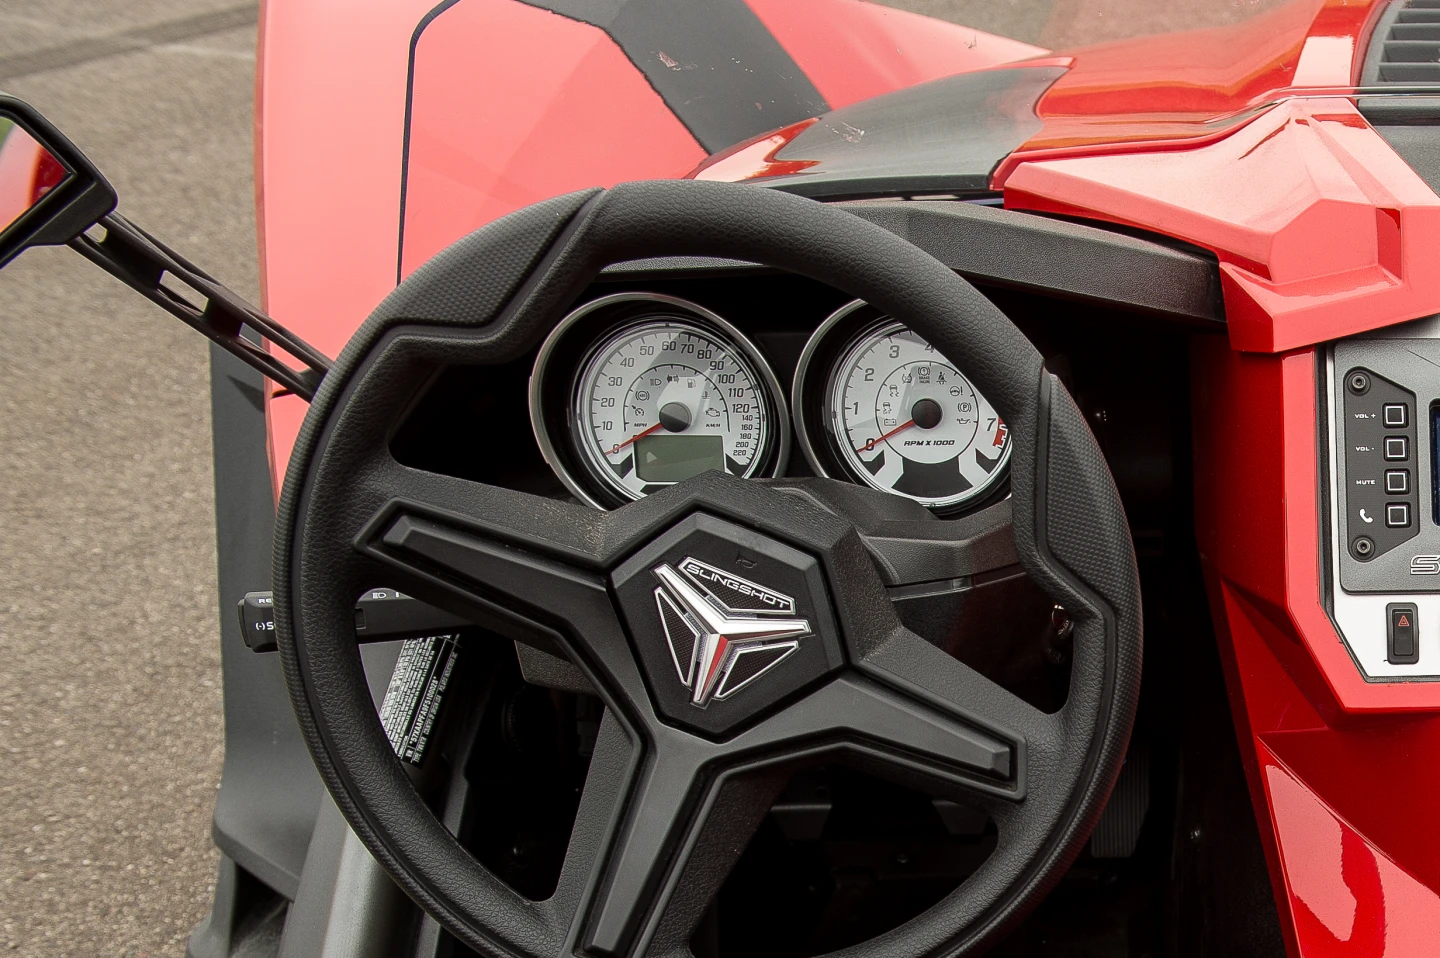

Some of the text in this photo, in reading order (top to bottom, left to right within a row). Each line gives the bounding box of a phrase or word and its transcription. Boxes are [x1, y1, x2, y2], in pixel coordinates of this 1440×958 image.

[639, 346, 654, 356] 50
[662, 342, 676, 350] 60
[680, 344, 694, 354] 70
[697, 350, 712, 360] 80
[889, 345, 900, 359] 3
[620, 358, 634, 368] 40
[710, 361, 724, 370] 90
[718, 374, 735, 384] 100
[864, 368, 875, 382] 2
[608, 376, 622, 386] 30
[728, 388, 744, 397] 110
[600, 398, 615, 407] 20
[732, 404, 750, 413] 120
[853, 402, 859, 415] 1
[602, 421, 613, 431] 10
[987, 418, 996, 431] 7
[866, 438, 875, 451] 0
[686, 563, 790, 609] SLINGSHOT
